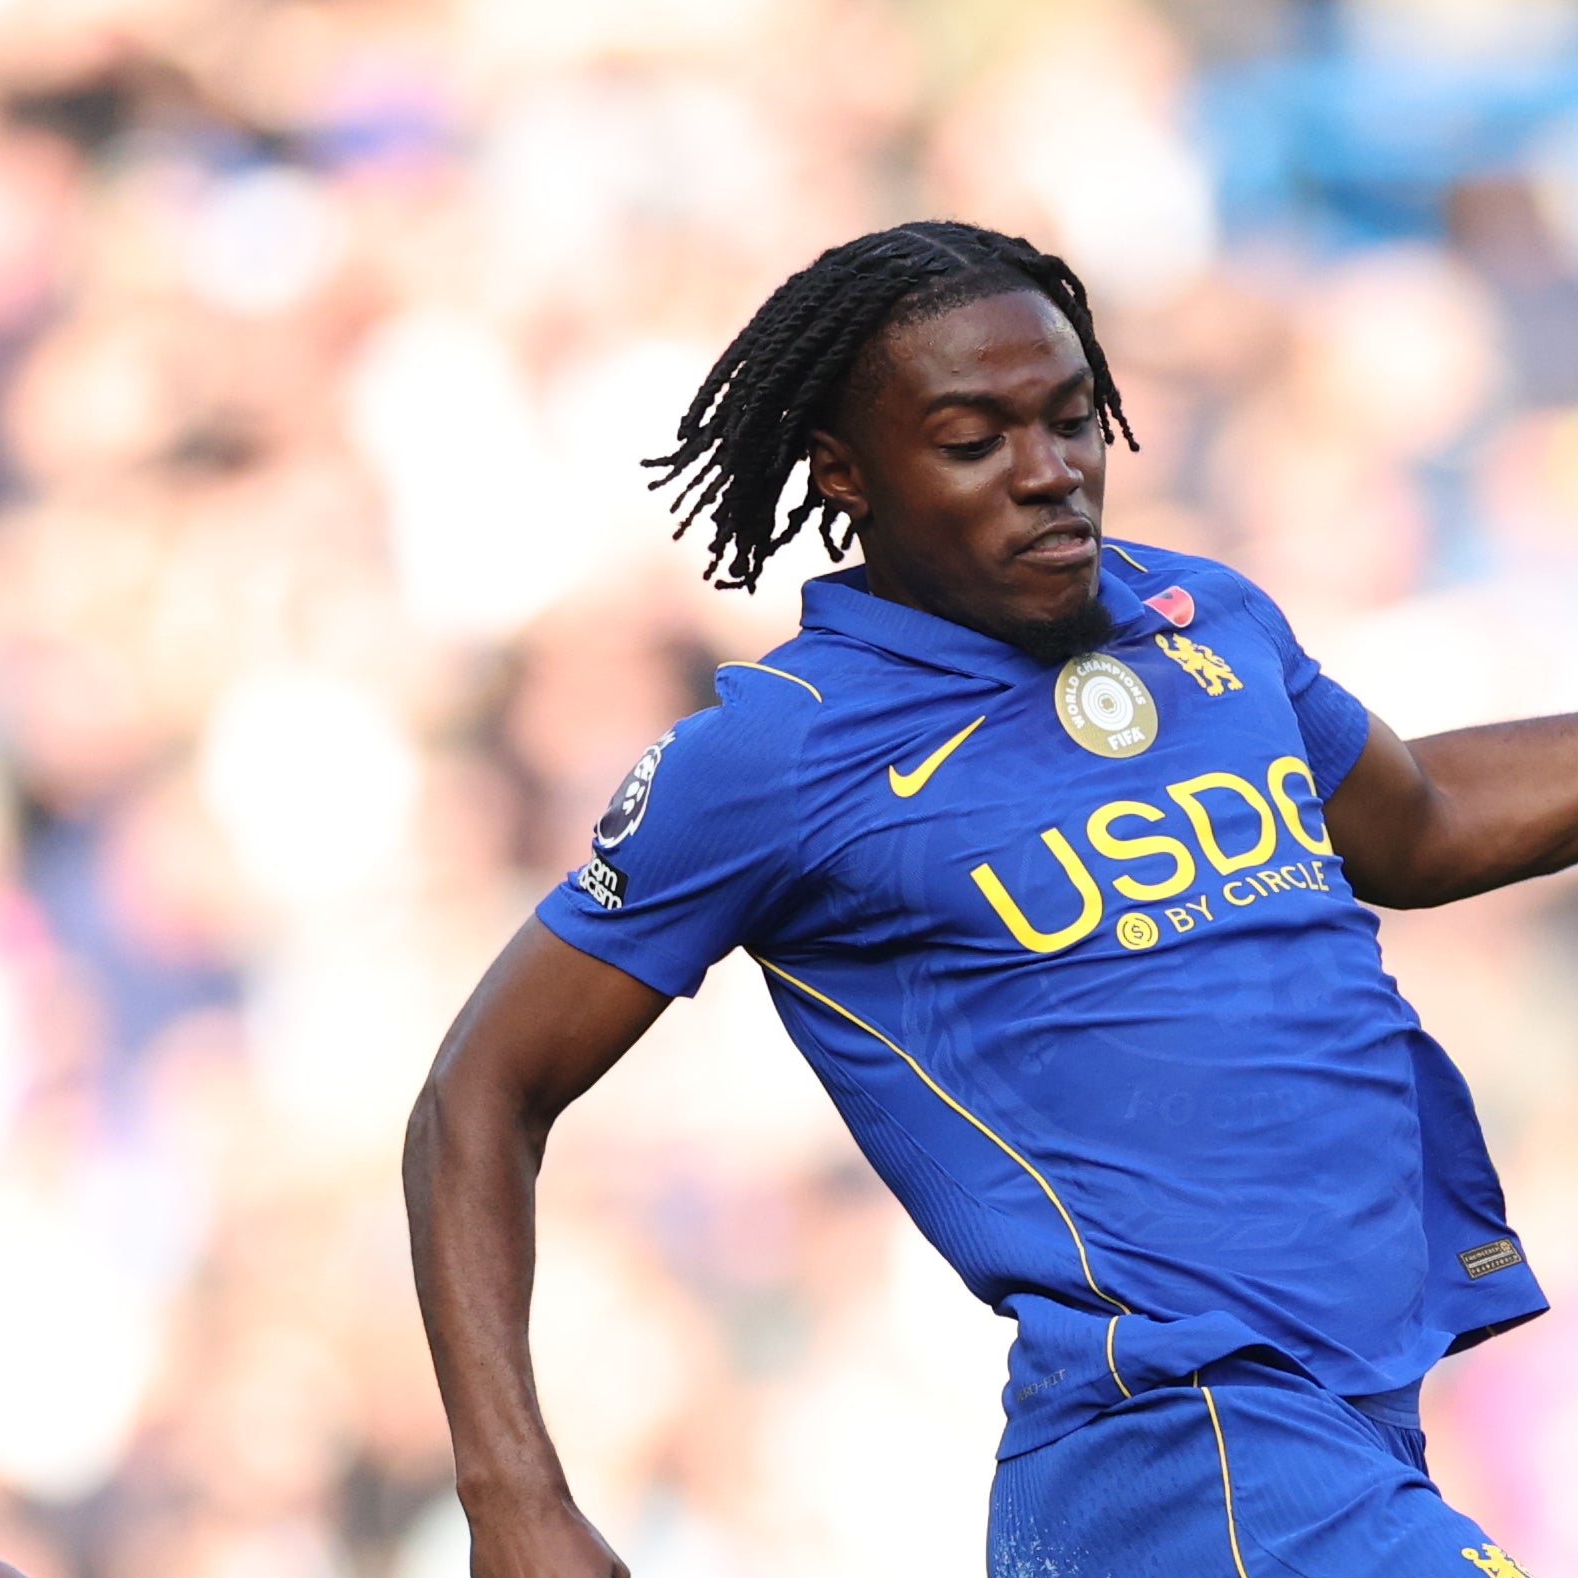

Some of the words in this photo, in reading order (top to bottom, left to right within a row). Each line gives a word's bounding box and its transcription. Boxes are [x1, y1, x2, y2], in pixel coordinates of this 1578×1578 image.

[1065, 675, 1086, 730] WORLD
[1076, 659, 1147, 706] CHAMPIONS
[1106, 726, 1146, 751] FIFA
[578, 868, 623, 911] acism
[1164, 894, 1214, 933] BY
[1223, 860, 1330, 907] CIRCLE
